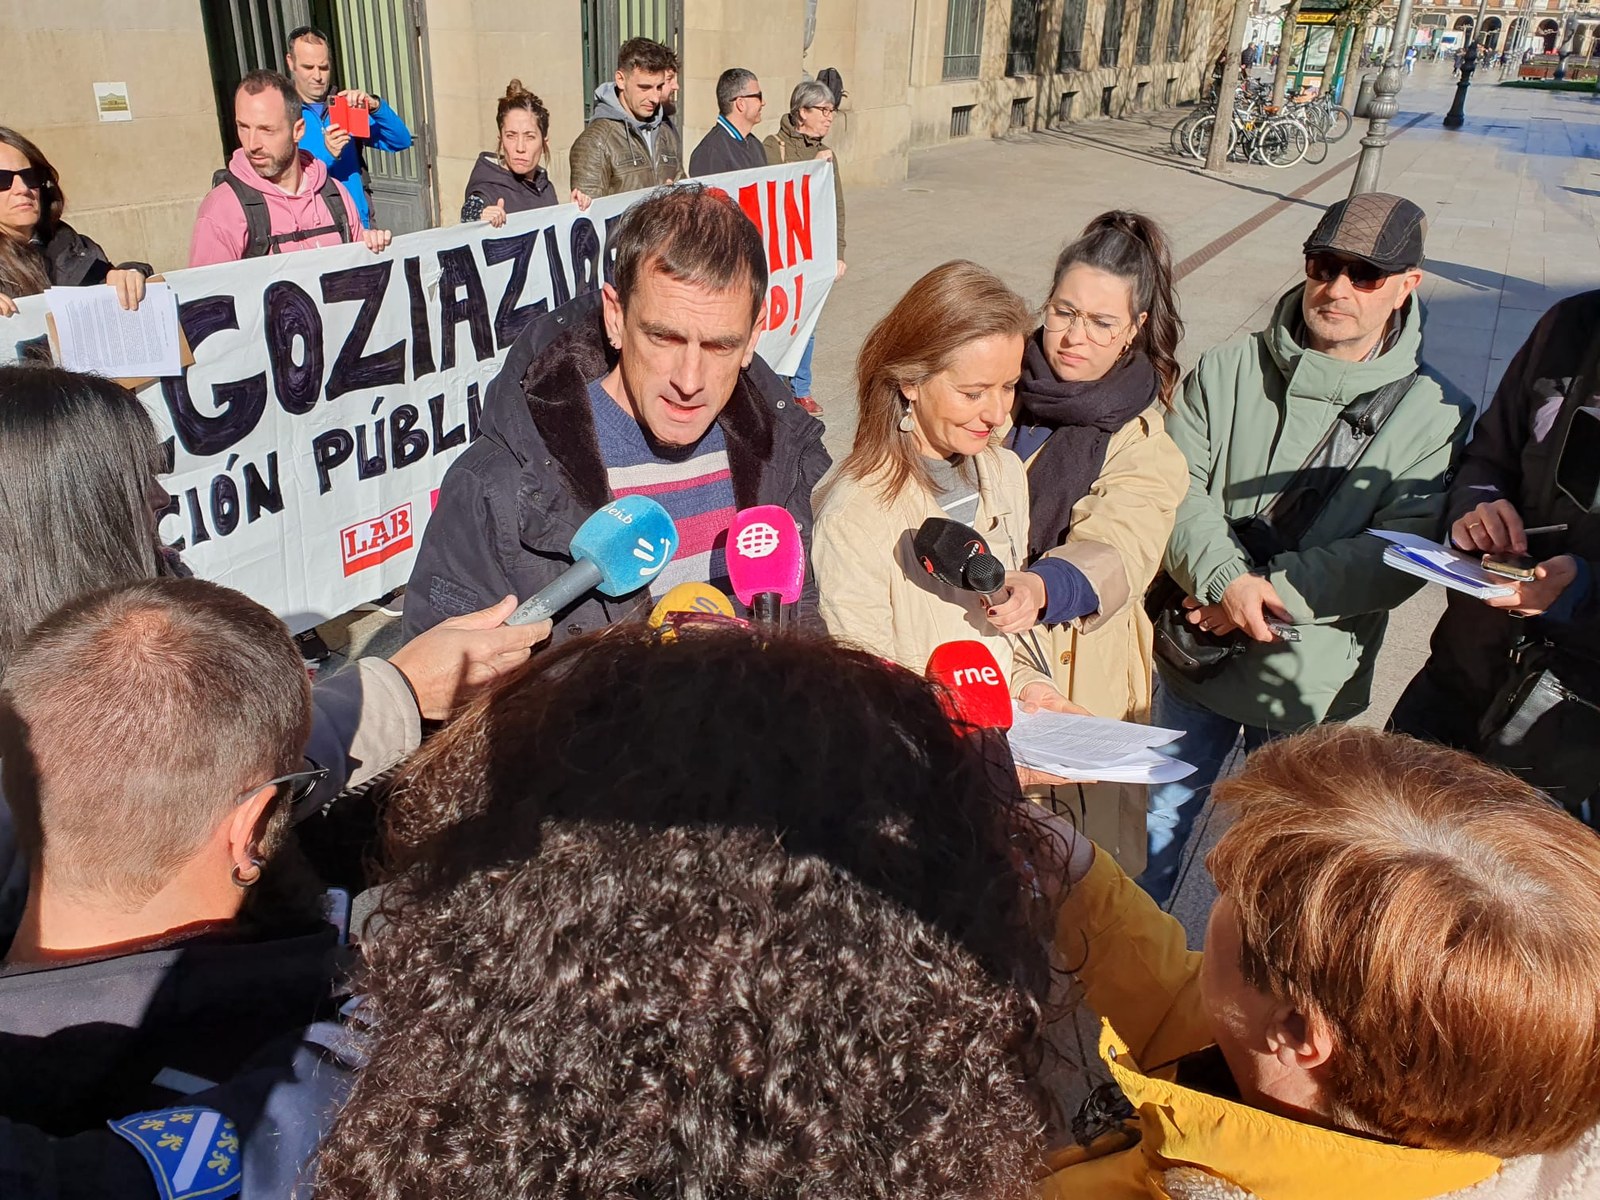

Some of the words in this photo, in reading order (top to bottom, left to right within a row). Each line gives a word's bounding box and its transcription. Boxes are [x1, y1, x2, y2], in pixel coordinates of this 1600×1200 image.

[15, 211, 622, 474] GOZIAZIO
[154, 451, 285, 552] CIÓN
[312, 382, 484, 496] PÚBLI
[345, 510, 409, 558] LAB
[953, 665, 999, 686] rne
